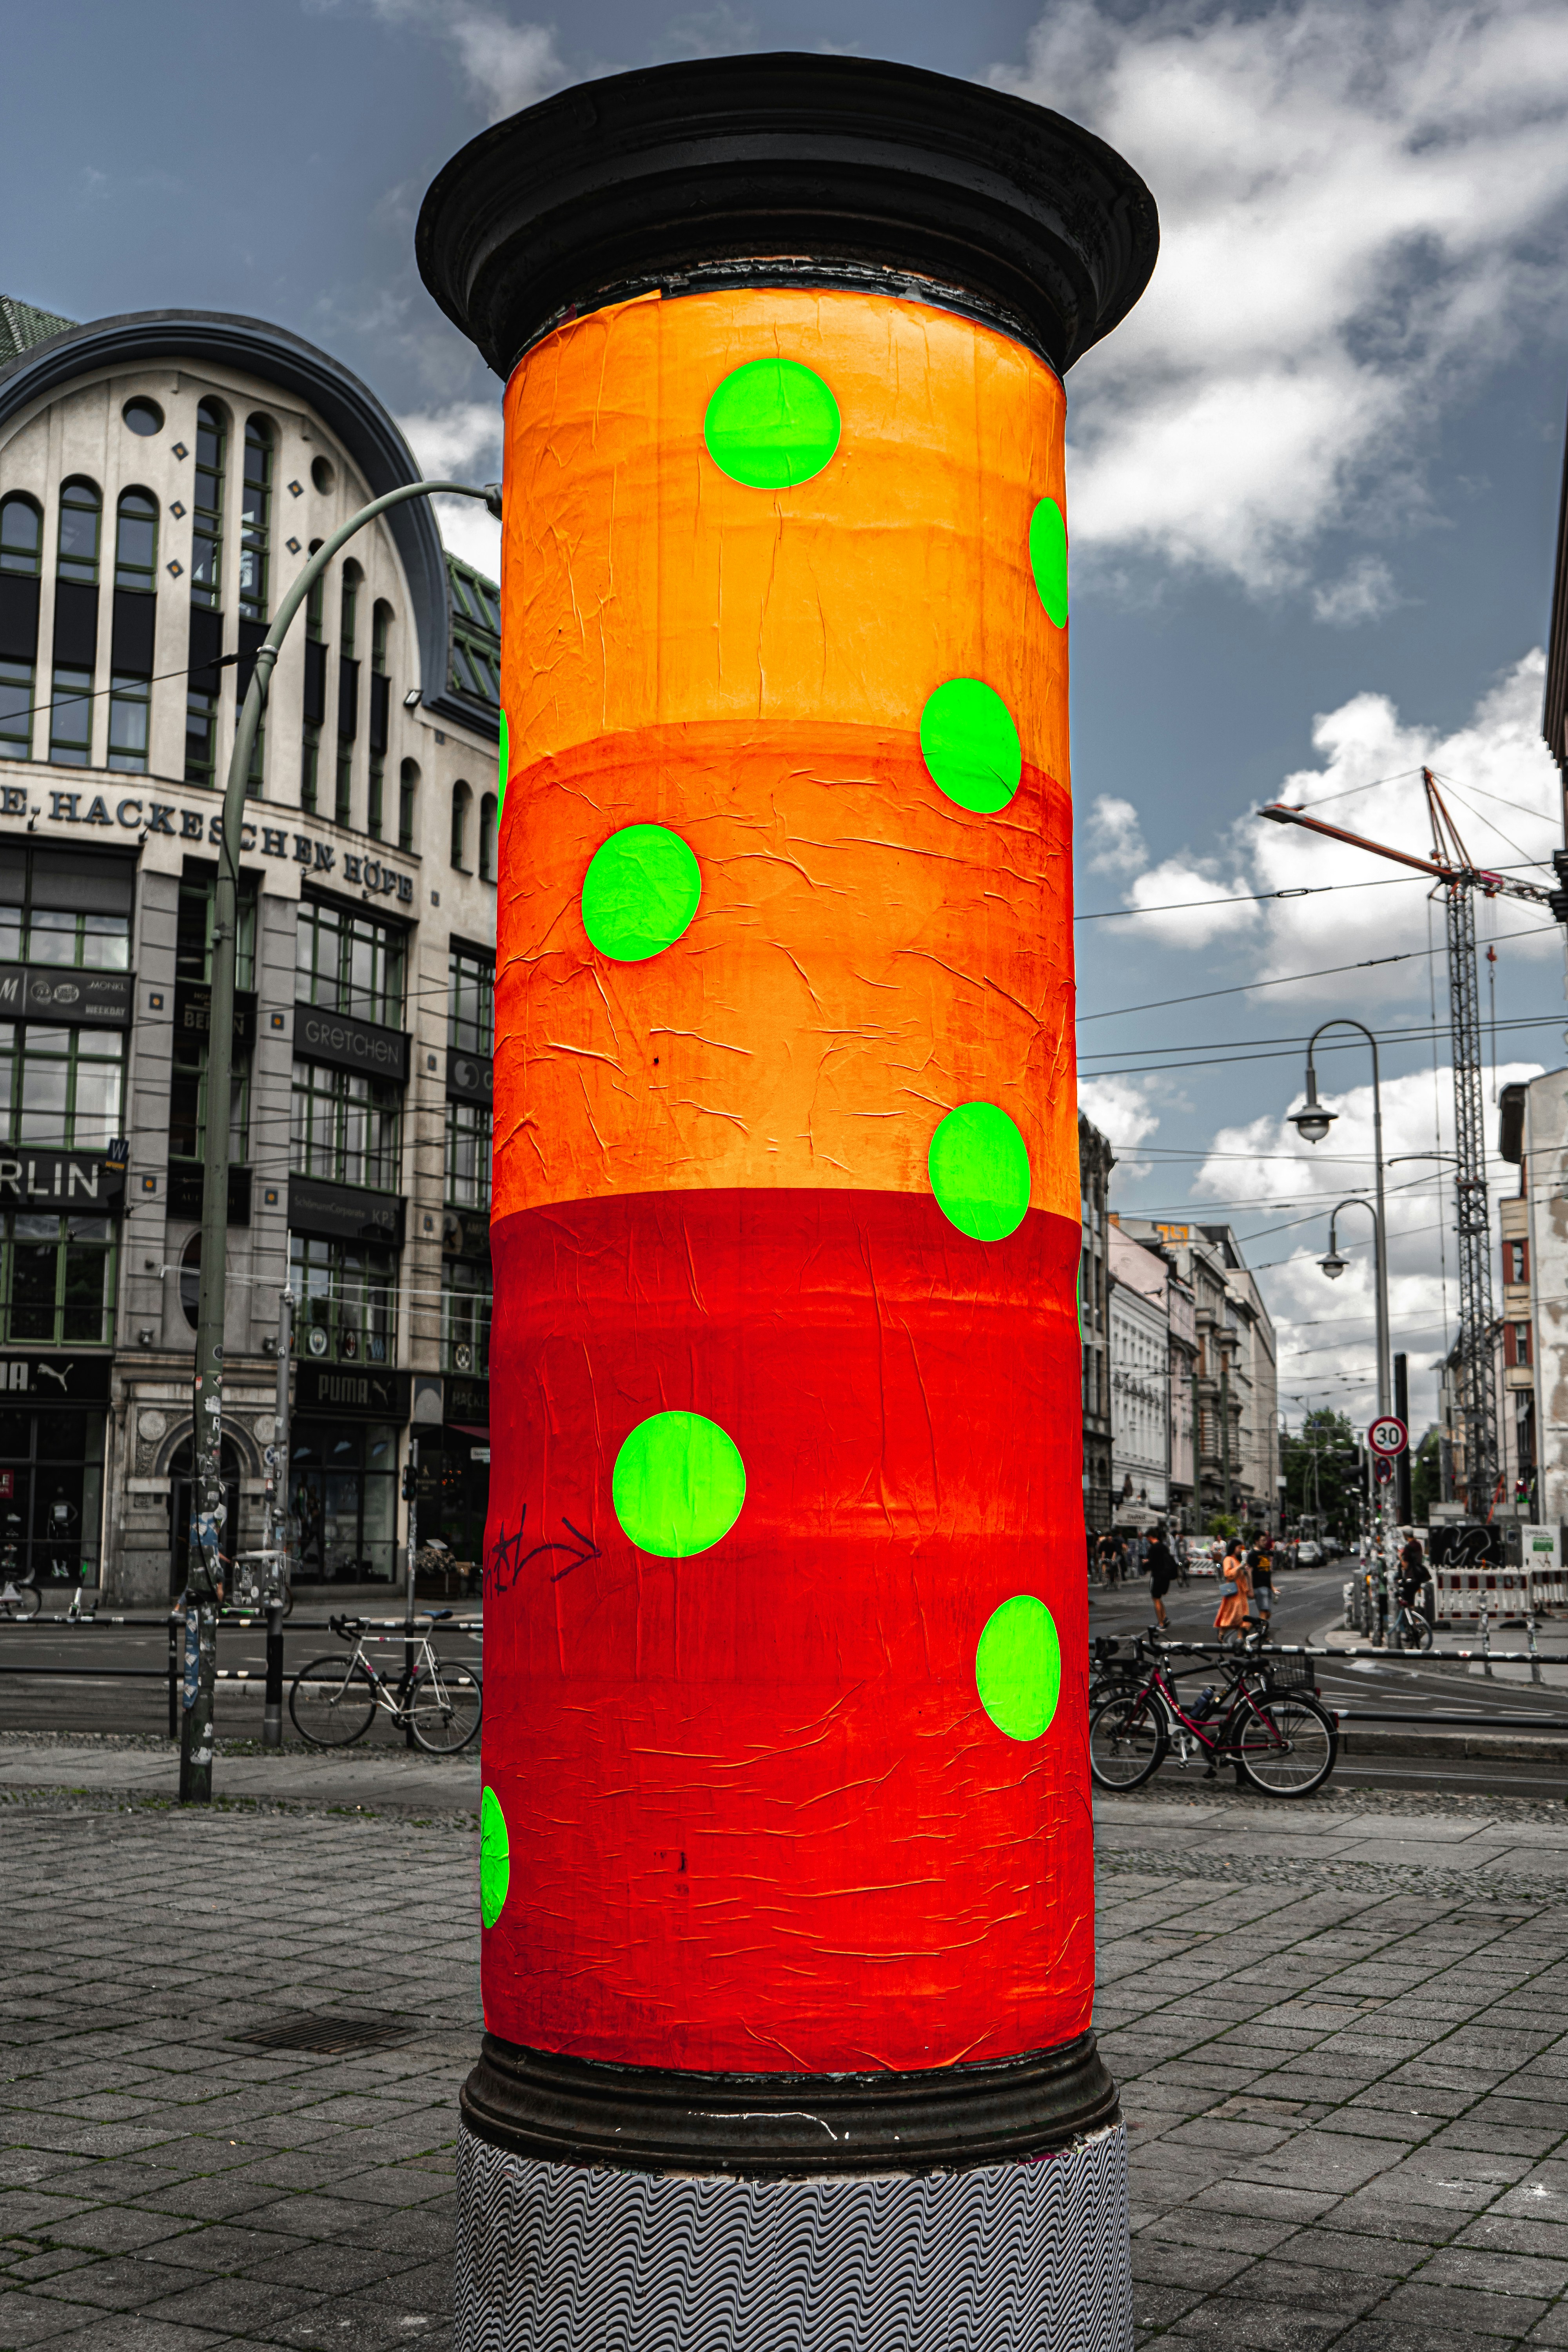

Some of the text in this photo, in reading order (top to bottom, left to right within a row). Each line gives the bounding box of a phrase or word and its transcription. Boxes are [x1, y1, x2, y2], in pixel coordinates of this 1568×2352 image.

[343, 852, 414, 904] HÖFE
[85, 1004, 126, 1017] WEEKDAY
[112, 1141, 126, 1161] W
[318, 1374, 368, 1404] PUMA
[1376, 1426, 1399, 1445] 30
